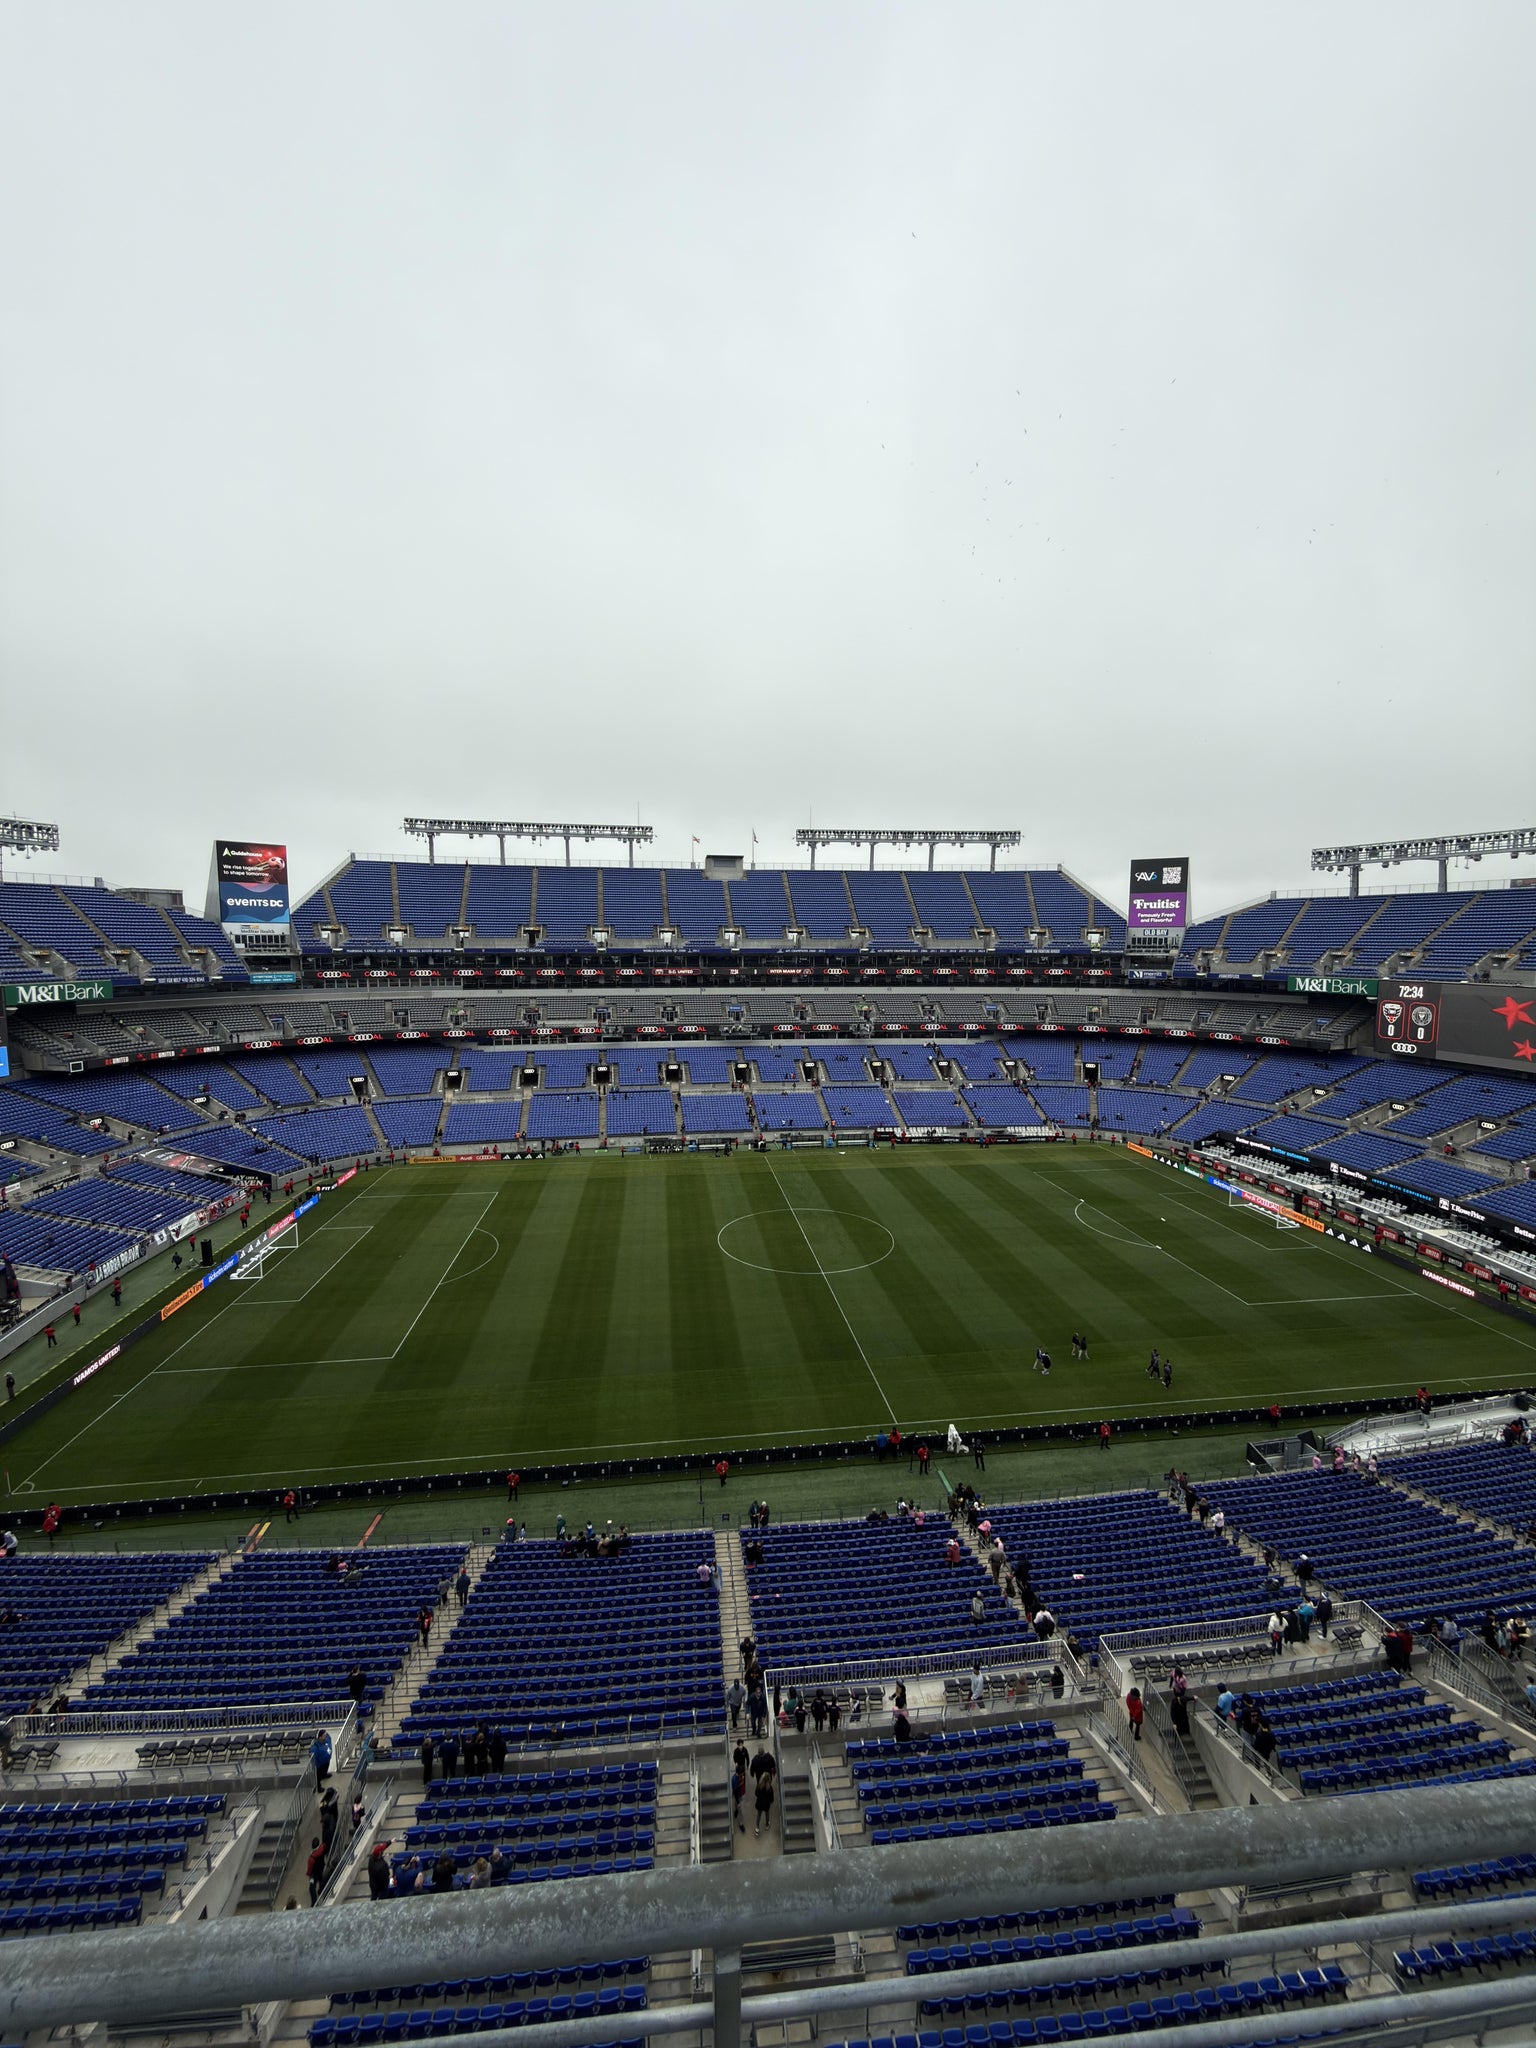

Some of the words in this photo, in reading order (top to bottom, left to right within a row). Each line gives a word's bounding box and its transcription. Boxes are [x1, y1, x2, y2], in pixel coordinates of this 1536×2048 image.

[1133, 899, 1180, 909] Fruitist
[1296, 978, 1332, 992] M&T
[1332, 979, 1368, 994] Bank
[1400, 986, 1424, 998] 72:34
[17, 984, 64, 1003] M&T
[65, 984, 104, 1000] Bank
[1388, 1025, 1394, 1036] 0
[1418, 1028, 1424, 1040] 0
[1272, 1147, 1286, 1155] Better
[1514, 1226, 1535, 1239] Better
[162, 1289, 190, 1316] Continental
